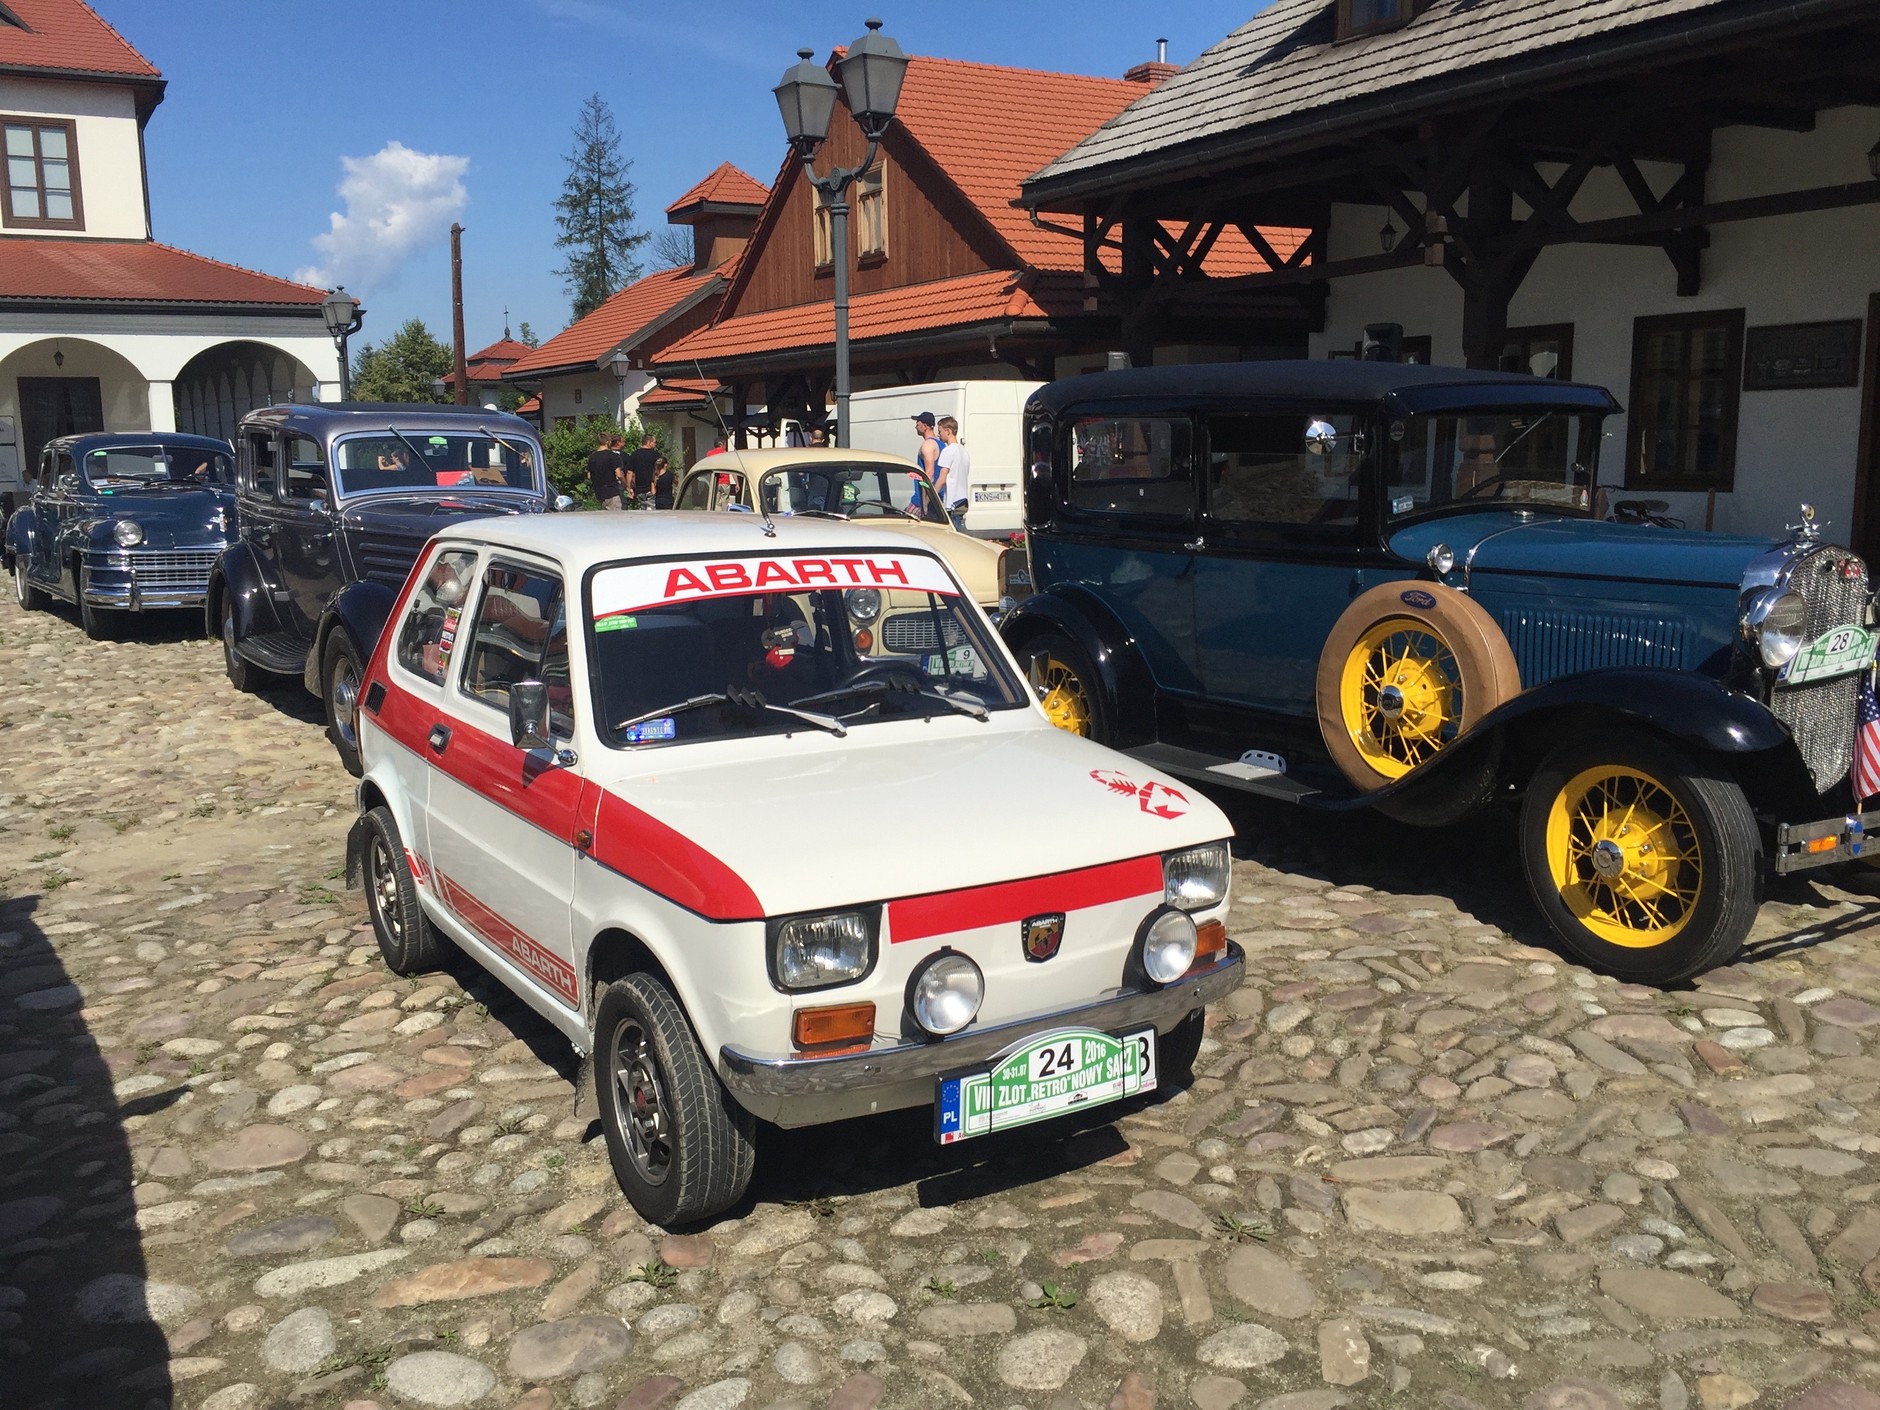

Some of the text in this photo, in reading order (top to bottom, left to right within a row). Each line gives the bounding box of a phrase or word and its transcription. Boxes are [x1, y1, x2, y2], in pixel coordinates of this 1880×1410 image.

[664, 559, 909, 598] ABARTH
[1404, 592, 1433, 606] Ford
[1830, 632, 1850, 652] 28
[963, 649, 971, 660] 9
[512, 936, 573, 993] ABARTH
[1038, 1043, 1074, 1078] 24
[1085, 1040, 1107, 1063] 2016
[1002, 1062, 1027, 1081] 30-31.07
[998, 1084, 1028, 1108] ZLOT
[1071, 1061, 1103, 1090] NOWY
[943, 1110, 958, 1125] PL
